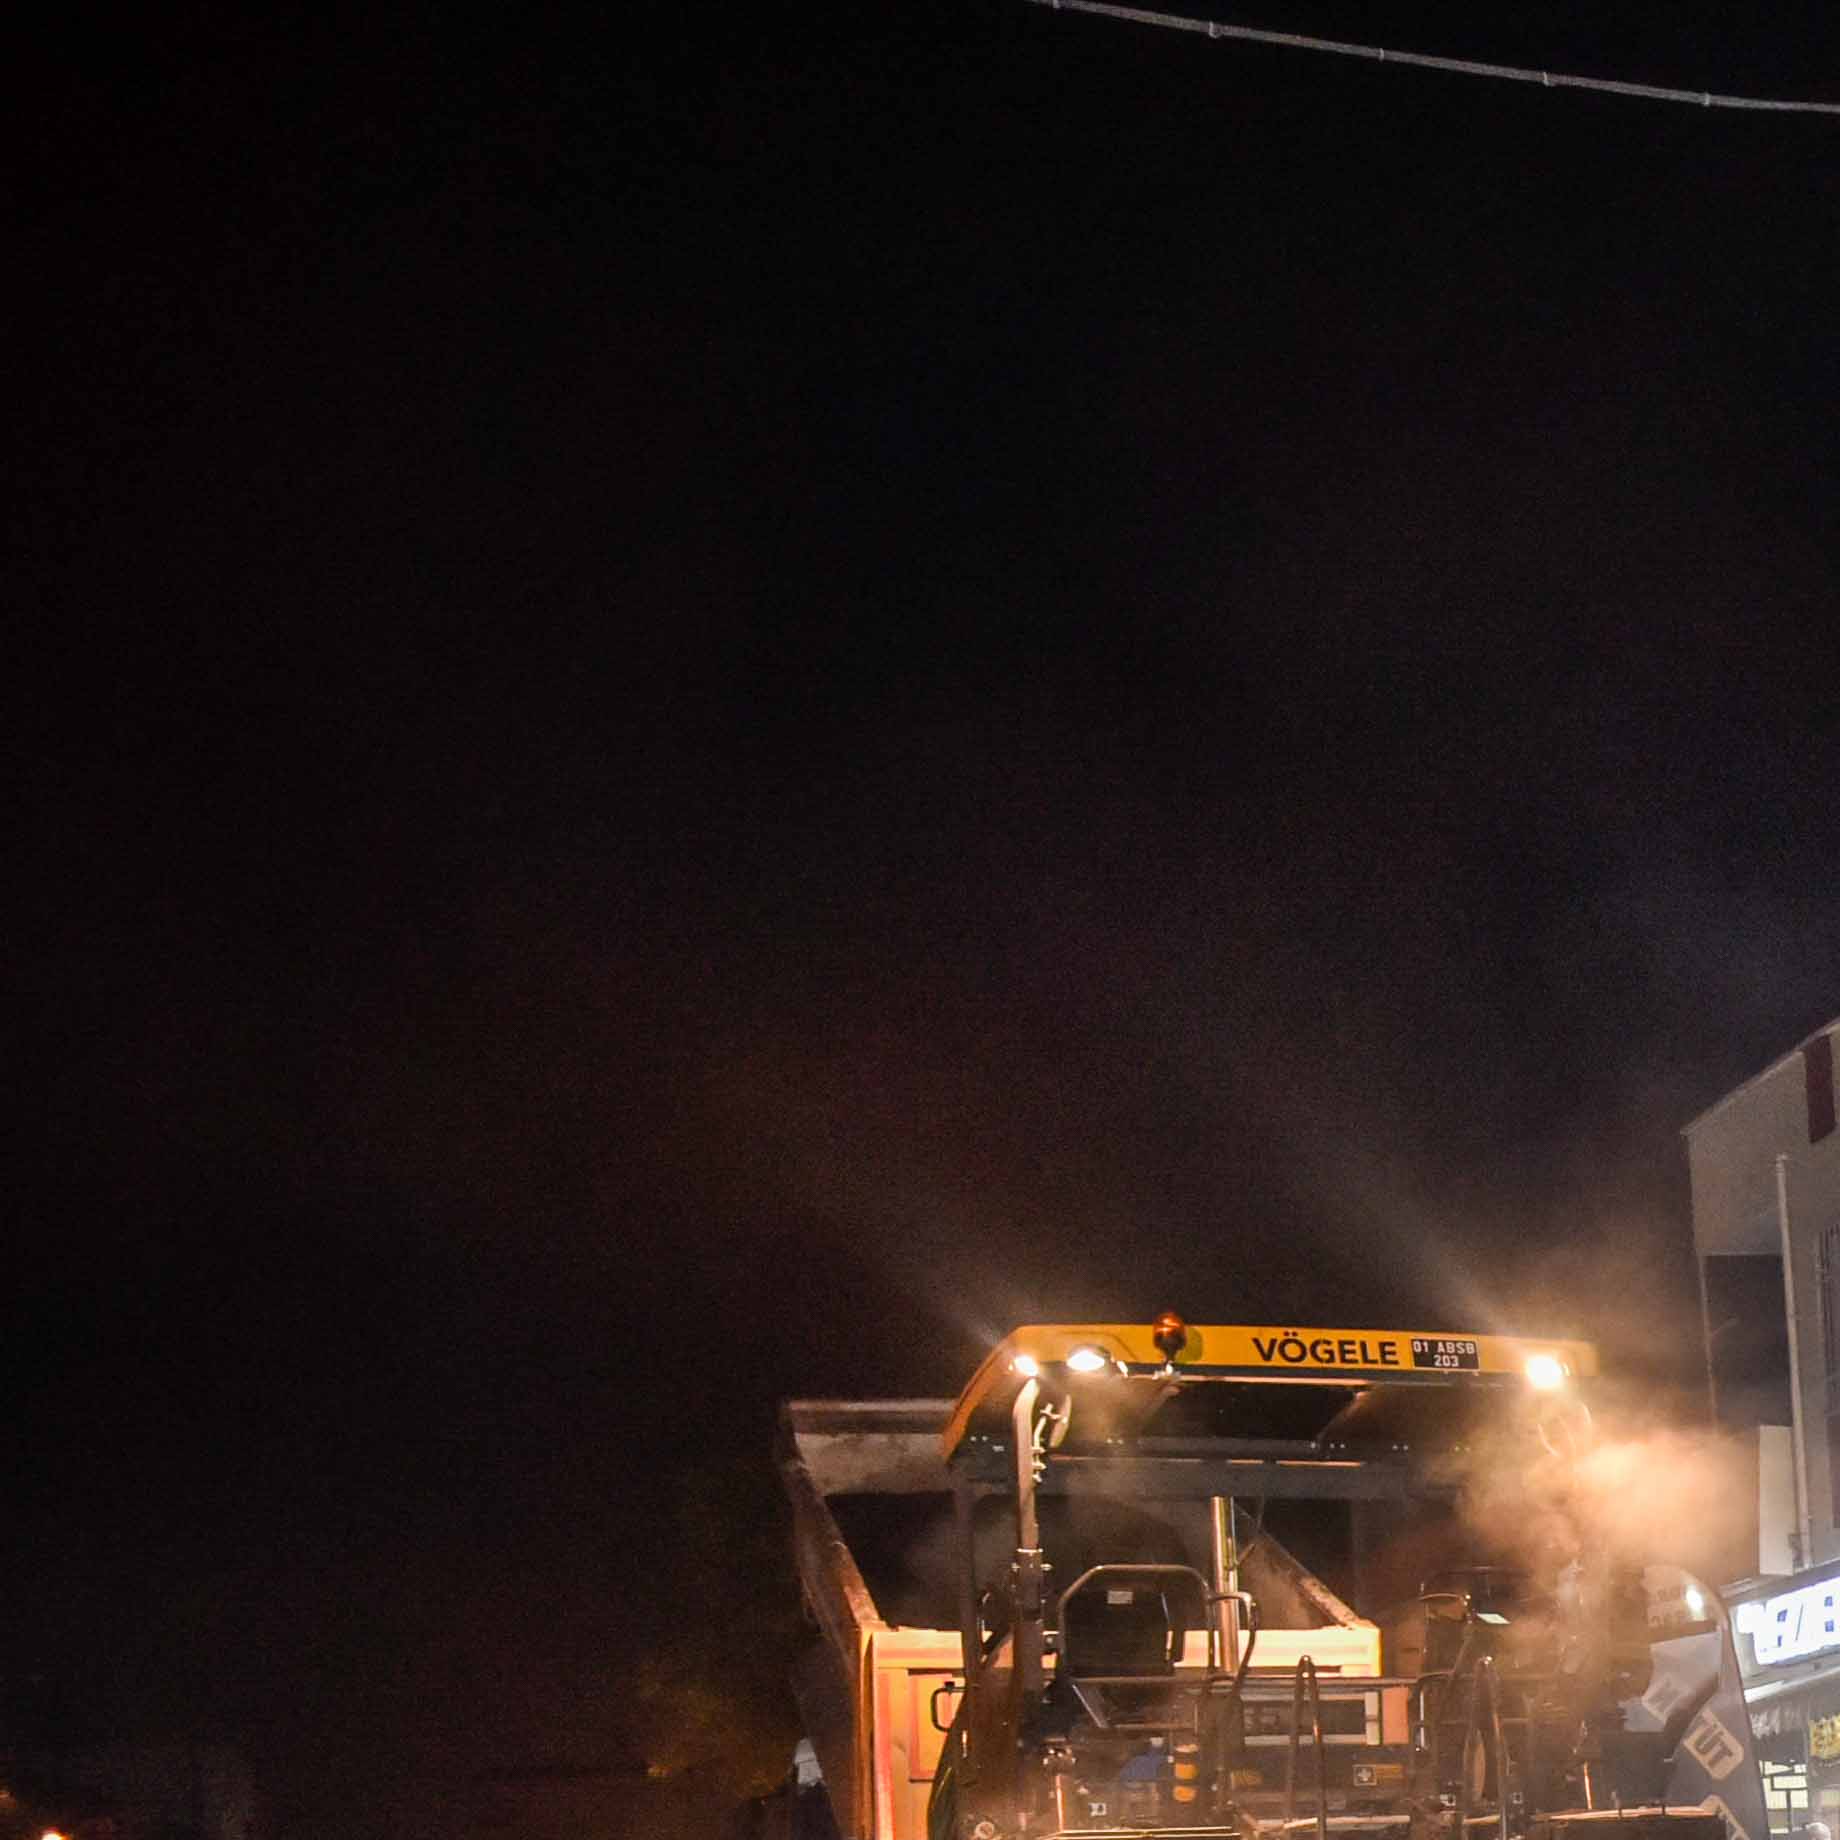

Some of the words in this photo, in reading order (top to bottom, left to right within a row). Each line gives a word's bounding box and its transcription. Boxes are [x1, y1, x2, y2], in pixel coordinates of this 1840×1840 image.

[1252, 1331, 1399, 1366] VÖGELE
[1412, 1340, 1429, 1353] 01
[1437, 1341, 1475, 1355] ABSB
[1434, 1354, 1459, 1367] 203
